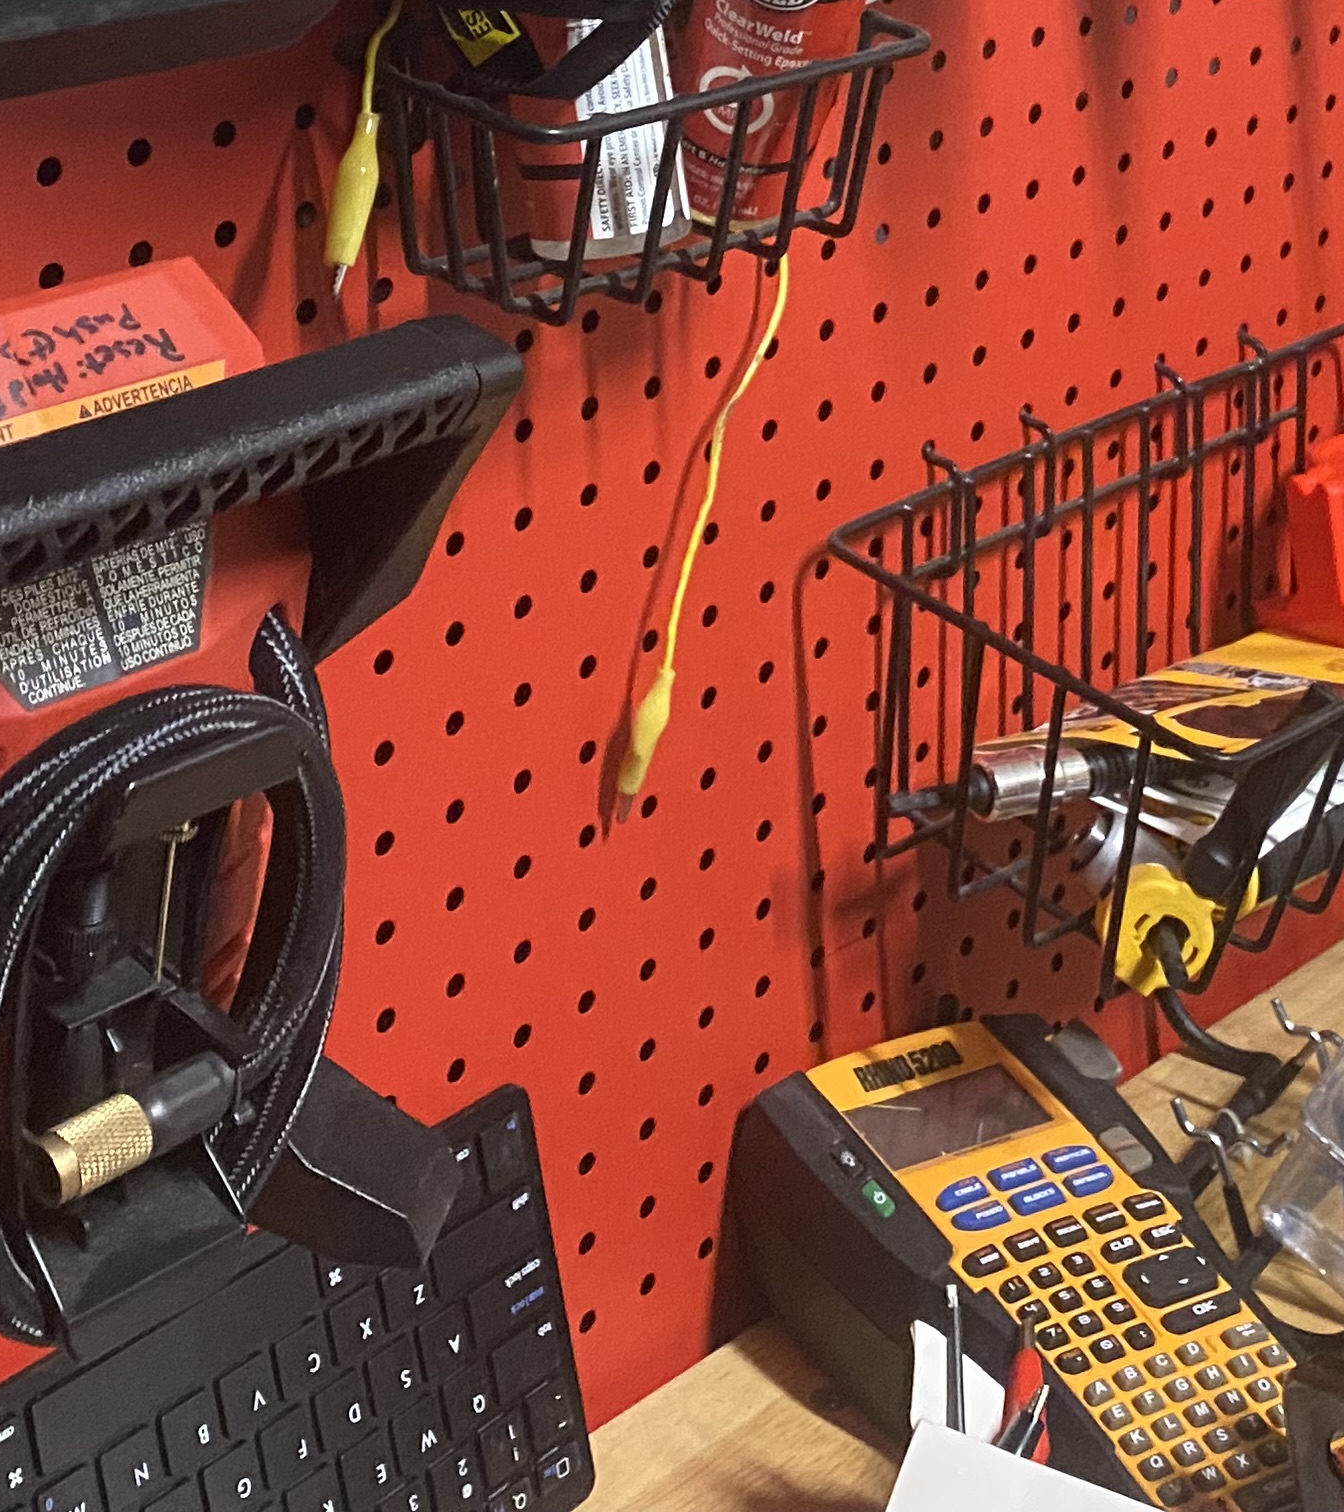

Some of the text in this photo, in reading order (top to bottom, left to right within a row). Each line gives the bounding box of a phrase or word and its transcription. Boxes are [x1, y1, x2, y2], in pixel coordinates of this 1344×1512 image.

[52, 303, 142, 345] Push
[93, 375, 195, 417] ADVERTENCIA
[147, 580, 200, 609] DURANTE
[139, 594, 198, 626] MINUTOS
[51, 627, 106, 656] CHAQUE
[40, 638, 109, 674] MINUTES
[412, 1283, 426, 1305] Z
[1191, 1300, 1218, 1317] OK
[358, 1317, 374, 1340] X
[447, 1333, 461, 1354] A
[307, 1352, 322, 1373] C
[400, 1368, 412, 1389] S
[251, 1389, 267, 1412] V
[472, 1393, 486, 1414] Q
[348, 1402, 362, 1424] D
[196, 1423, 211, 1444] B
[420, 1429, 438, 1454] W
[296, 1438, 309, 1460] F
[132, 1461, 151, 1487] N
[374, 1462, 388, 1485] E
[236, 1476, 253, 1500] G
